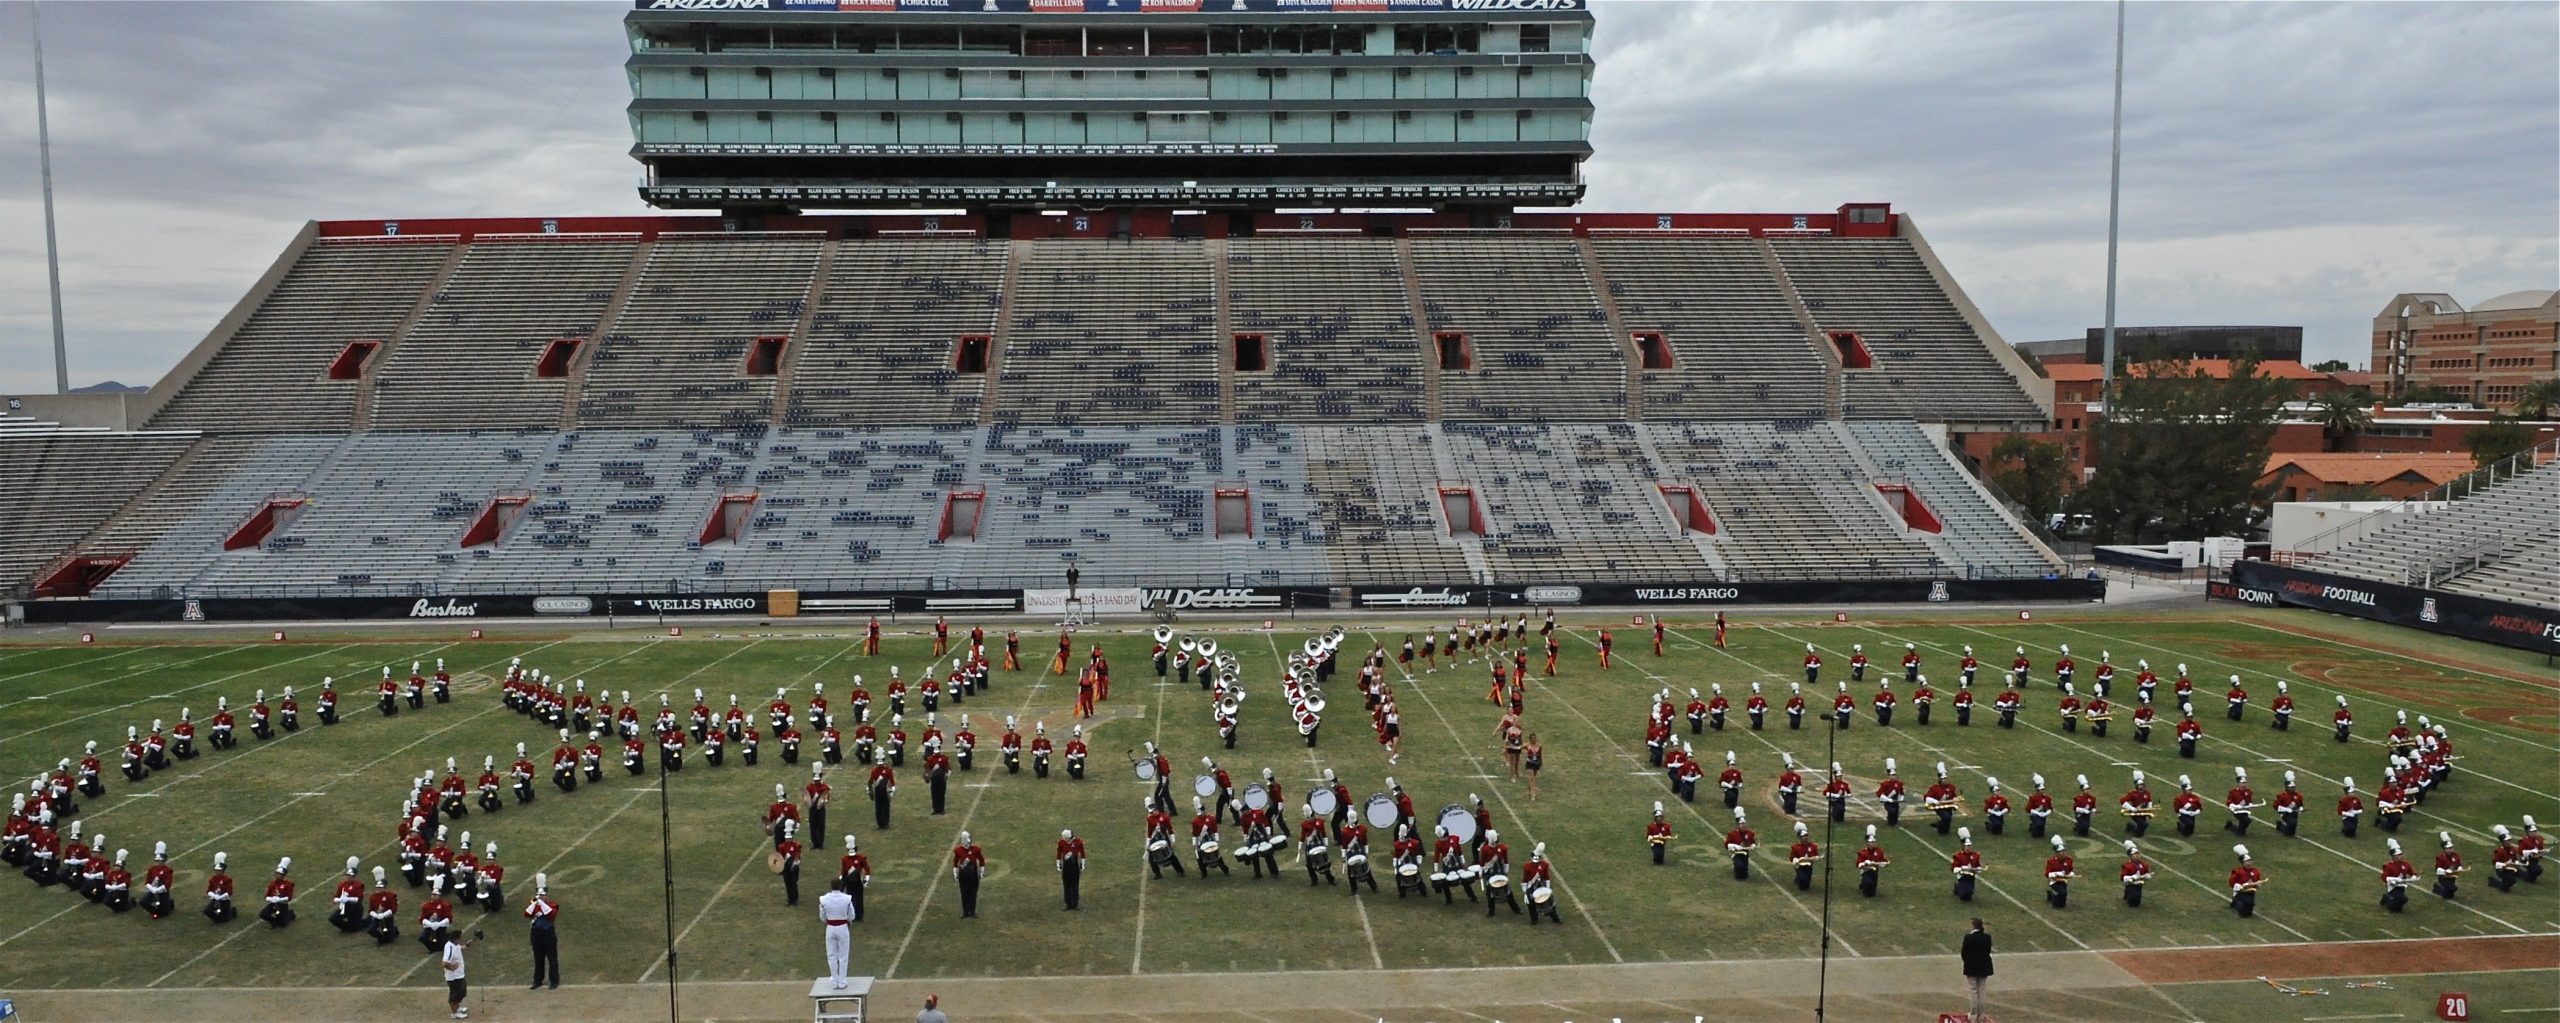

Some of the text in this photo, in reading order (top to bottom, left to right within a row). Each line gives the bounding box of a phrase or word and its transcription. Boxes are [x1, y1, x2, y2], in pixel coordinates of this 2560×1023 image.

[649, 0, 769, 9] ARIZONA
[1452, 0, 1576, 9] WILDCATS
[544, 224, 556, 234] 18
[724, 223, 735, 232] 19
[925, 222, 938, 231] 20
[1076, 221, 1087, 230] 21
[1301, 220, 1313, 229] 22
[1499, 220, 1510, 229] 23
[1658, 220, 1670, 230] 24
[1794, 221, 1807, 230] 25
[386, 227, 397, 236] 17
[10, 400, 20, 409] 16
[1635, 588, 1738, 600] WELLS FARGO
[2211, 583, 2273, 604] BEAR DOWN
[2322, 586, 2376, 606] FOOTBALL
[648, 598, 756, 611] WELLS FARGO
[1104, 595, 1123, 606] BAND
[1124, 595, 1139, 605] DAY
[408, 599, 478, 617] Bashas'
[2446, 998, 2466, 1017] 20
